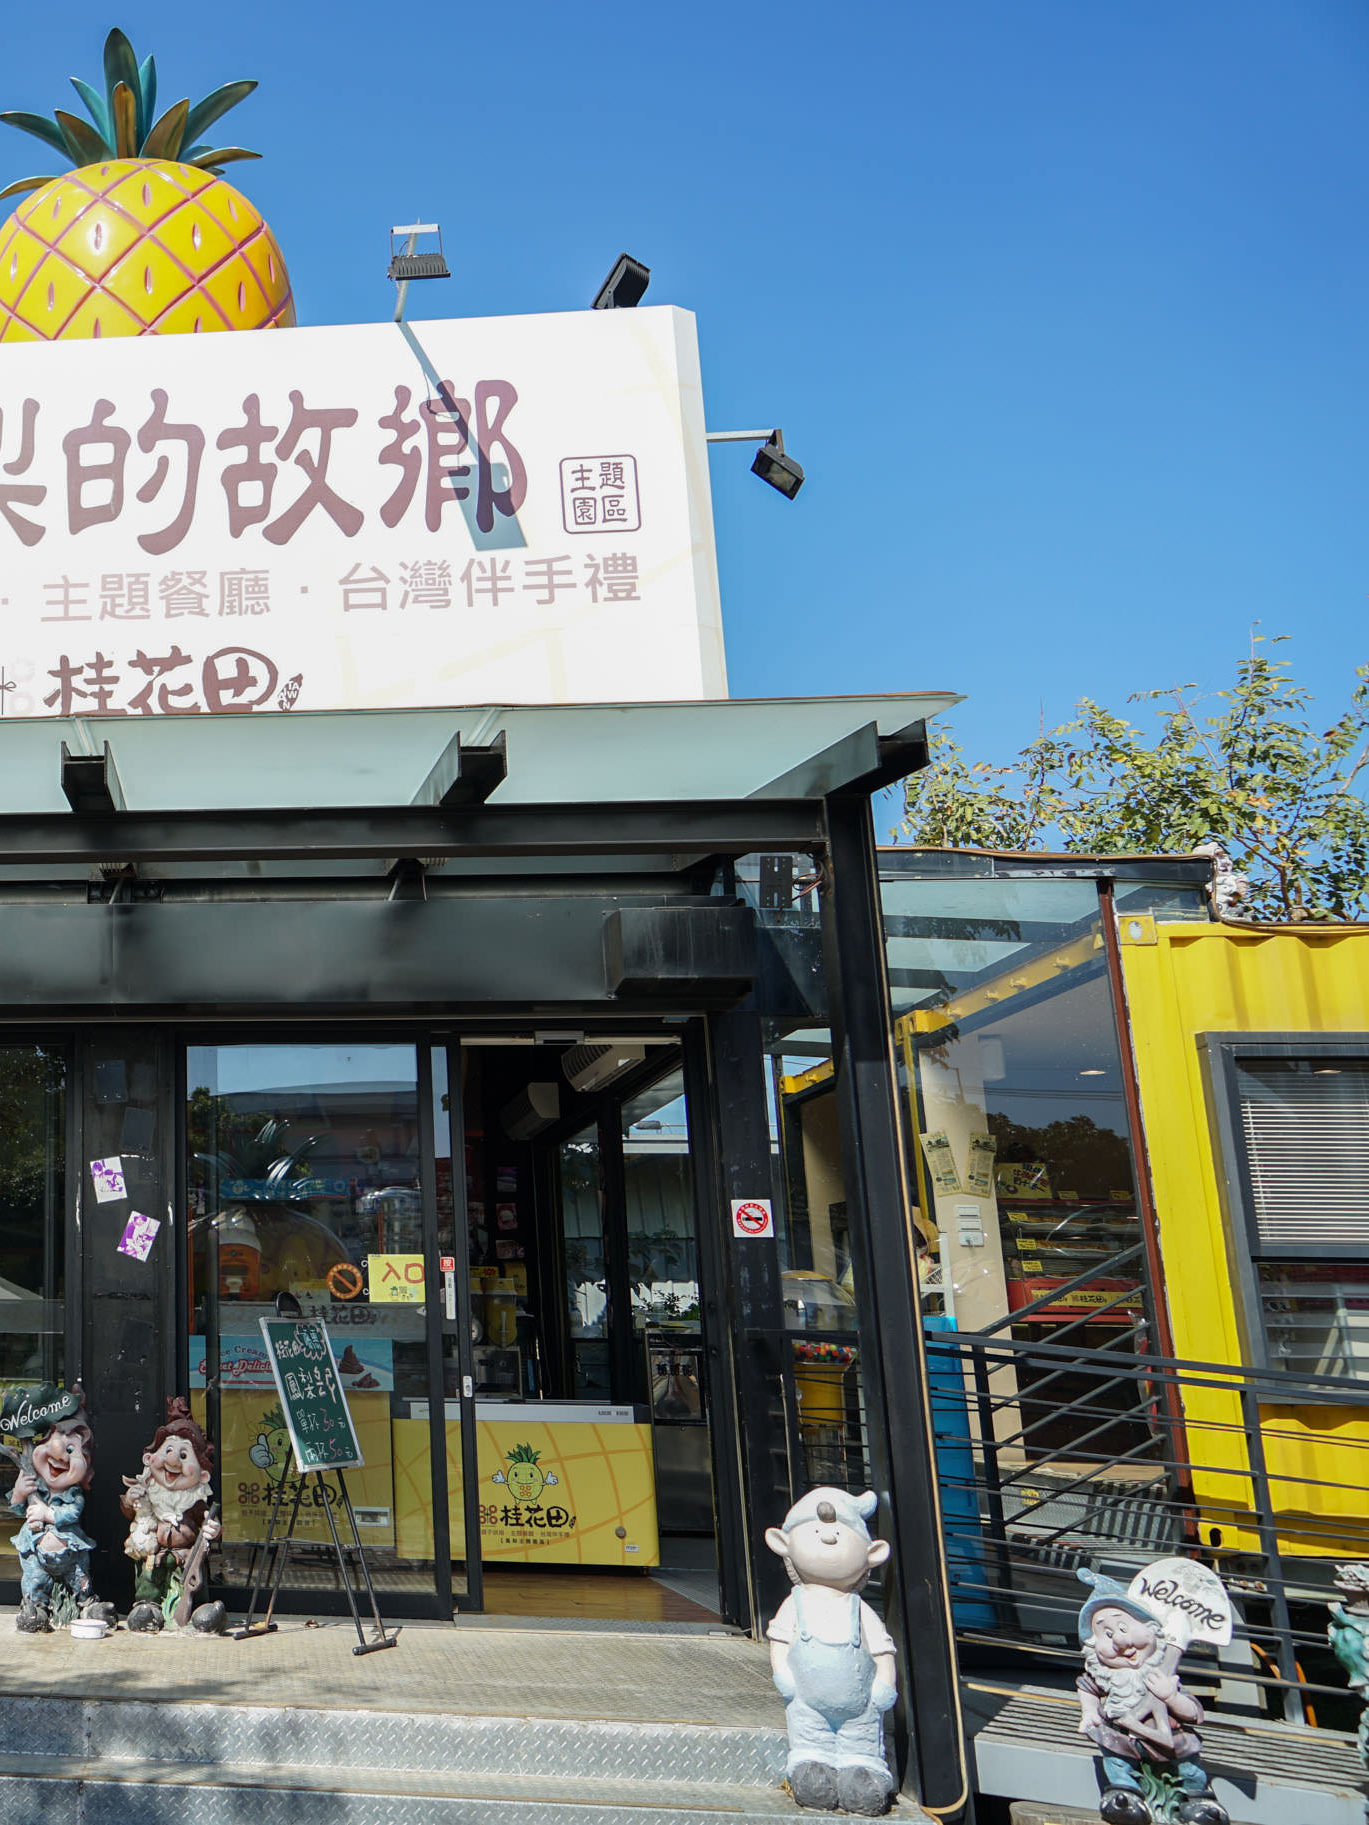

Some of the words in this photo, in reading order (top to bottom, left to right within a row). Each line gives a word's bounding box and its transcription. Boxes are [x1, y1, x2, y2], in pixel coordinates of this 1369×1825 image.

[570, 461, 626, 493] 主題
[572, 494, 628, 525] 園區
[40, 567, 271, 622] 主題餐廳
[338, 552, 641, 612] 台灣伴手禮
[43, 645, 279, 716] 桂花田
[381, 1262, 425, 1284] 入口
[0, 1395, 72, 1431] Welcome
[500, 1504, 569, 1528] 桂花田
[1140, 1577, 1226, 1630] Welcome
